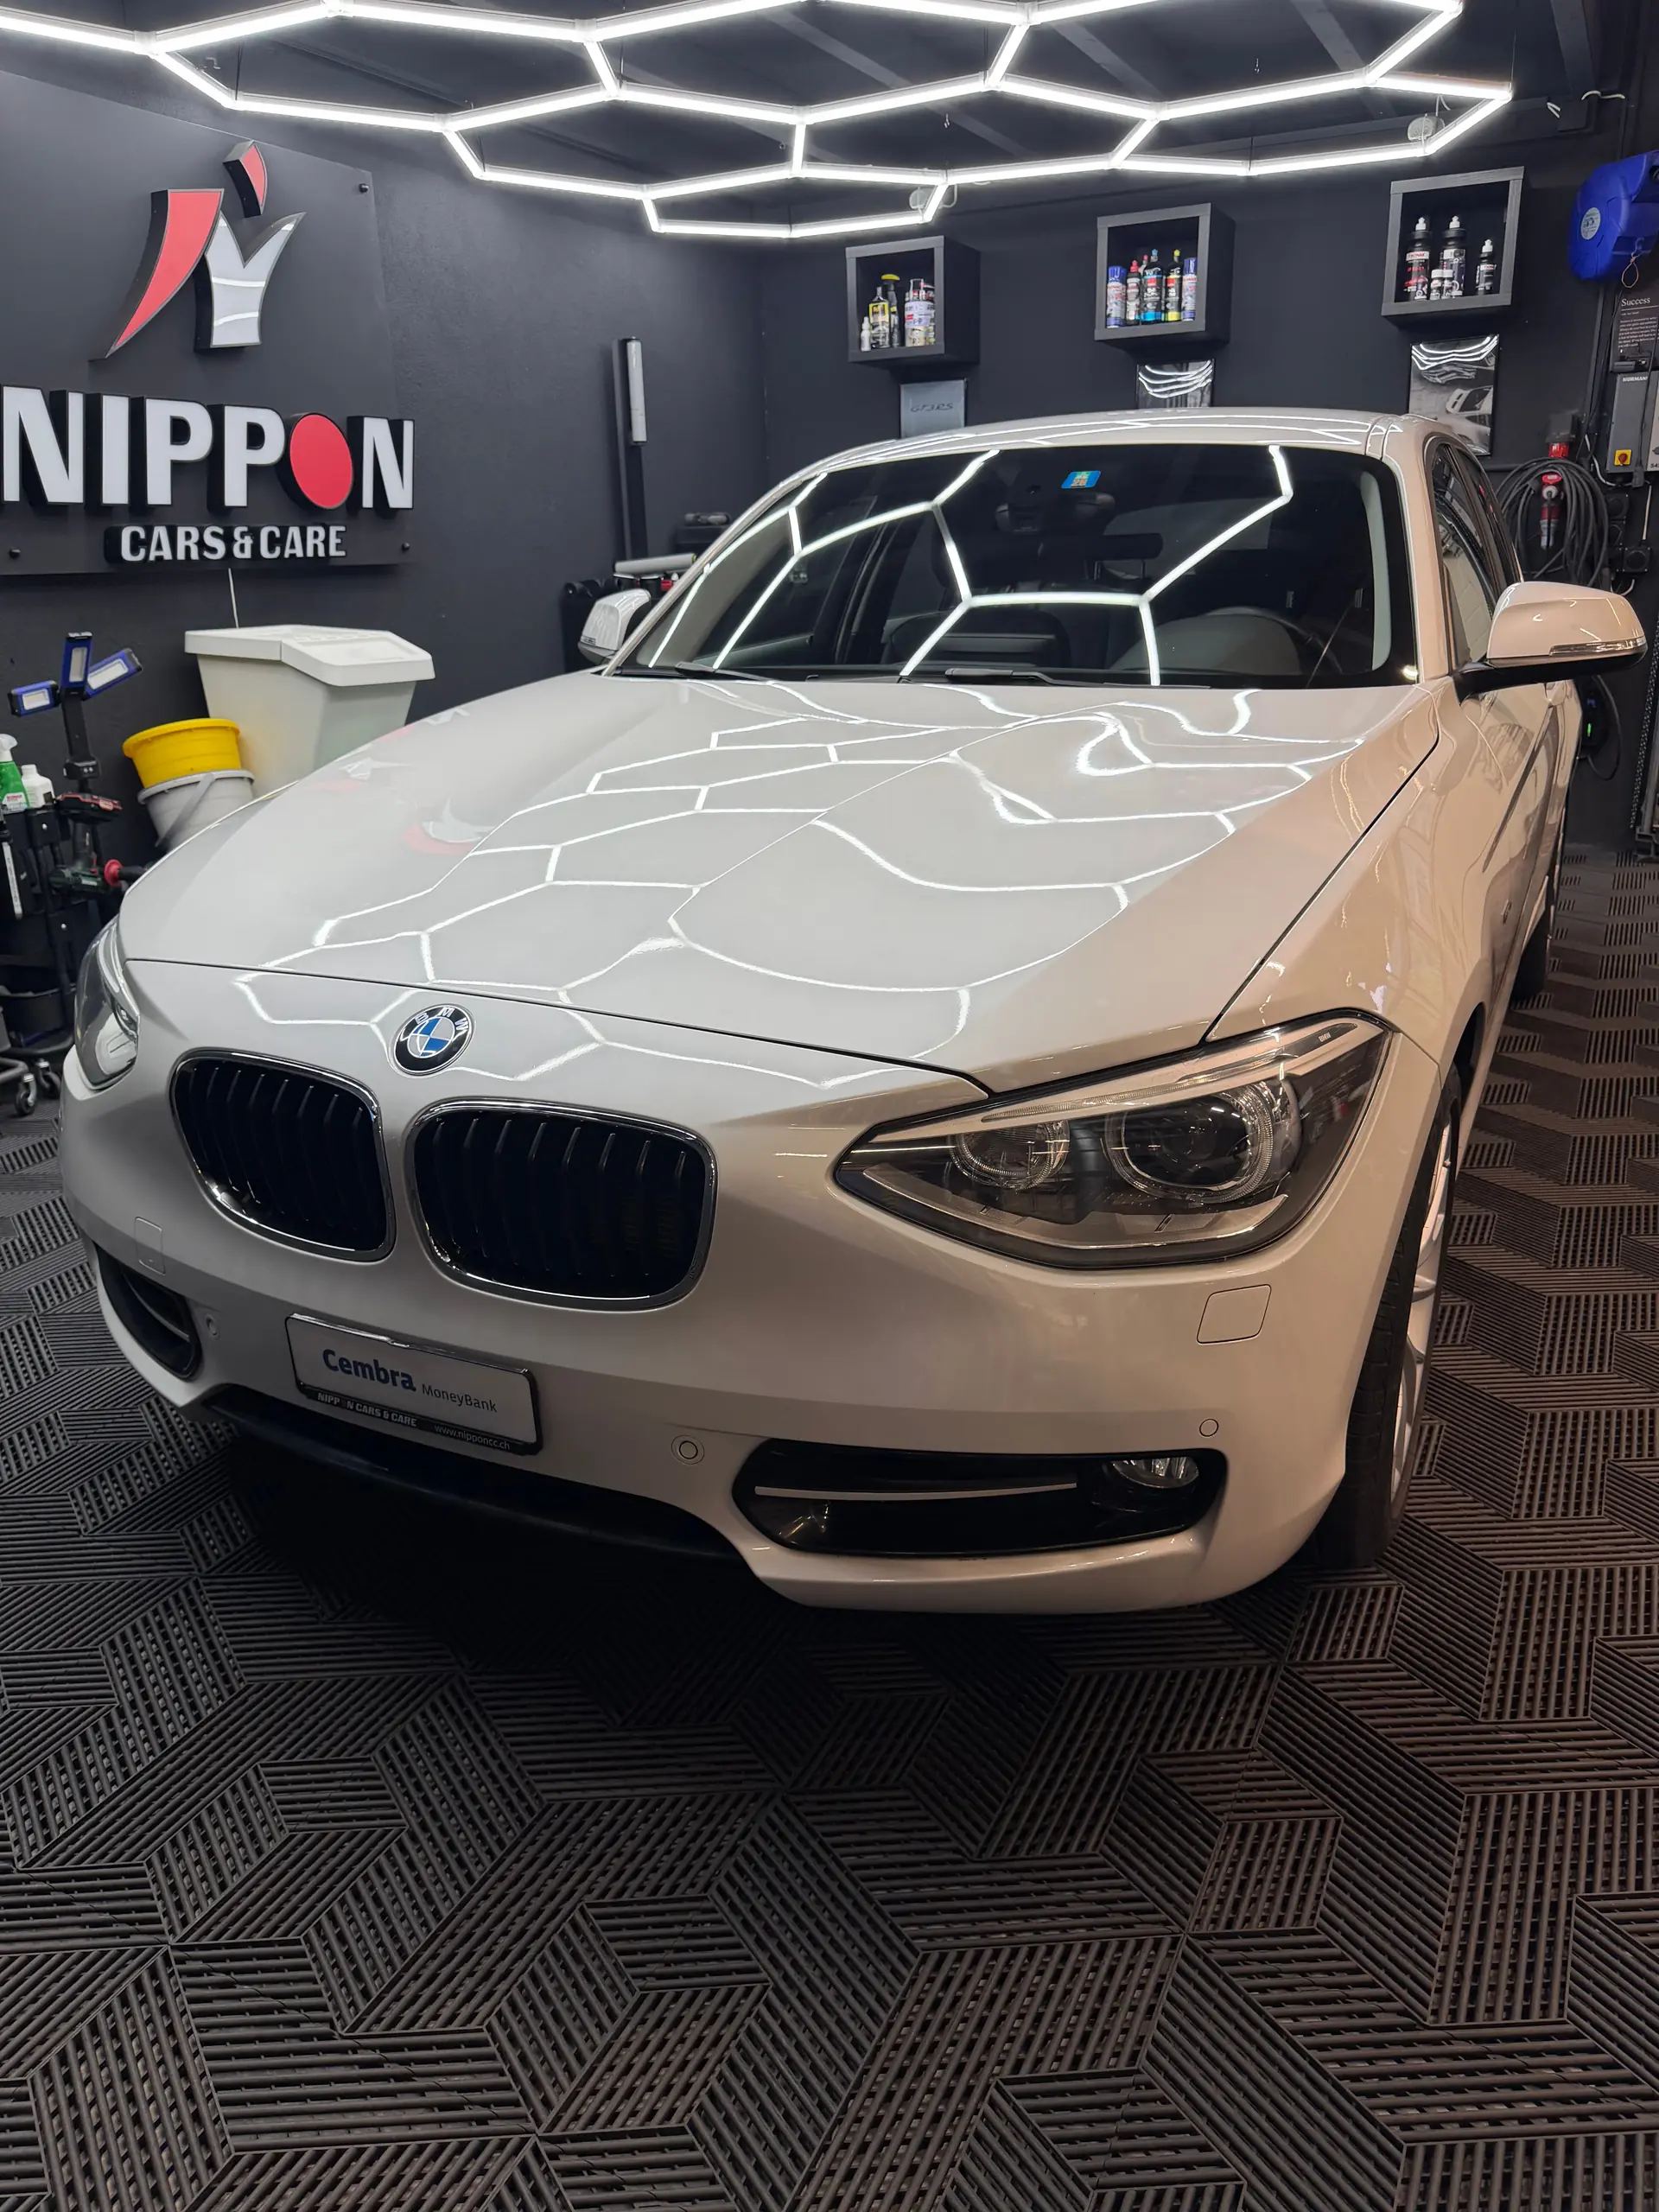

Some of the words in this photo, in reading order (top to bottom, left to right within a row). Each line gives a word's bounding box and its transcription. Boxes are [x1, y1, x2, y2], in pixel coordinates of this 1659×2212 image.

[1621, 297, 1651, 307] Success
[3, 385, 415, 510] NIPPON
[121, 525, 226, 562] CARS
[233, 525, 253, 560] &
[259, 525, 347, 560] CARE
[1318, 1032, 1332, 1042] BMW
[323, 1349, 416, 1392] Cembra
[423, 1384, 498, 1413] MoneyBank
[355, 1402, 382, 1418] CARS
[391, 1413, 417, 1427] CARE
[434, 1424, 511, 1451] www.nipponcc.ch
